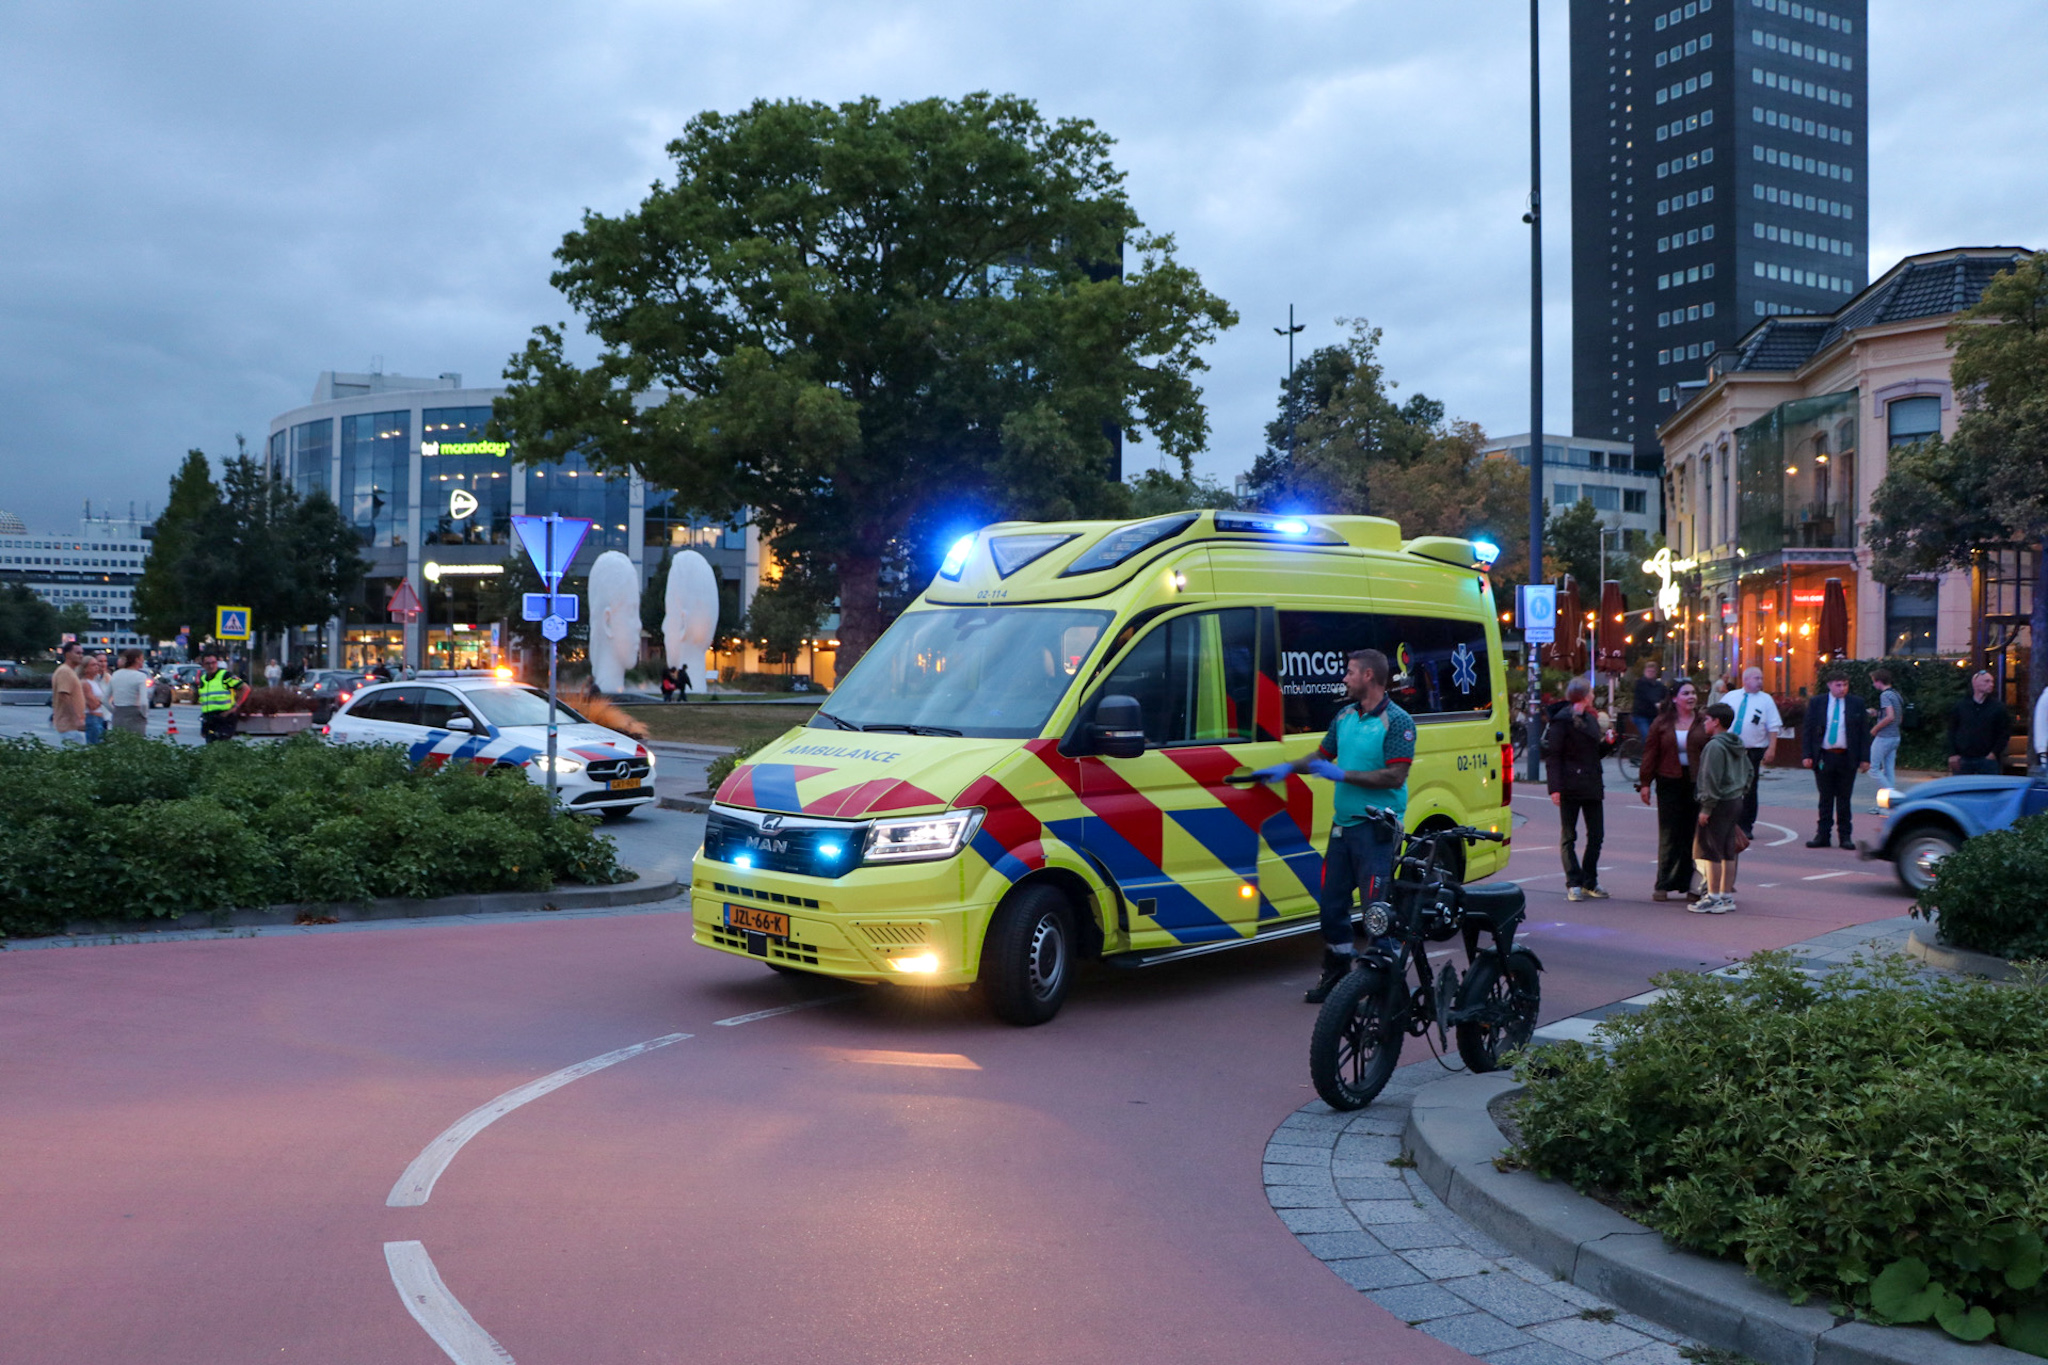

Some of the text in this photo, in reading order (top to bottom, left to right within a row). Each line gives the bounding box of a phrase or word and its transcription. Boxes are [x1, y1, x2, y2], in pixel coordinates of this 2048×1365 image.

[977, 590, 1007, 599] 02-114
[782, 745, 901, 763] AMBULANCE
[1457, 753, 1487, 771] 02-114
[745, 836, 788, 853] MAN
[733, 908, 782, 932] JZL-66-K
